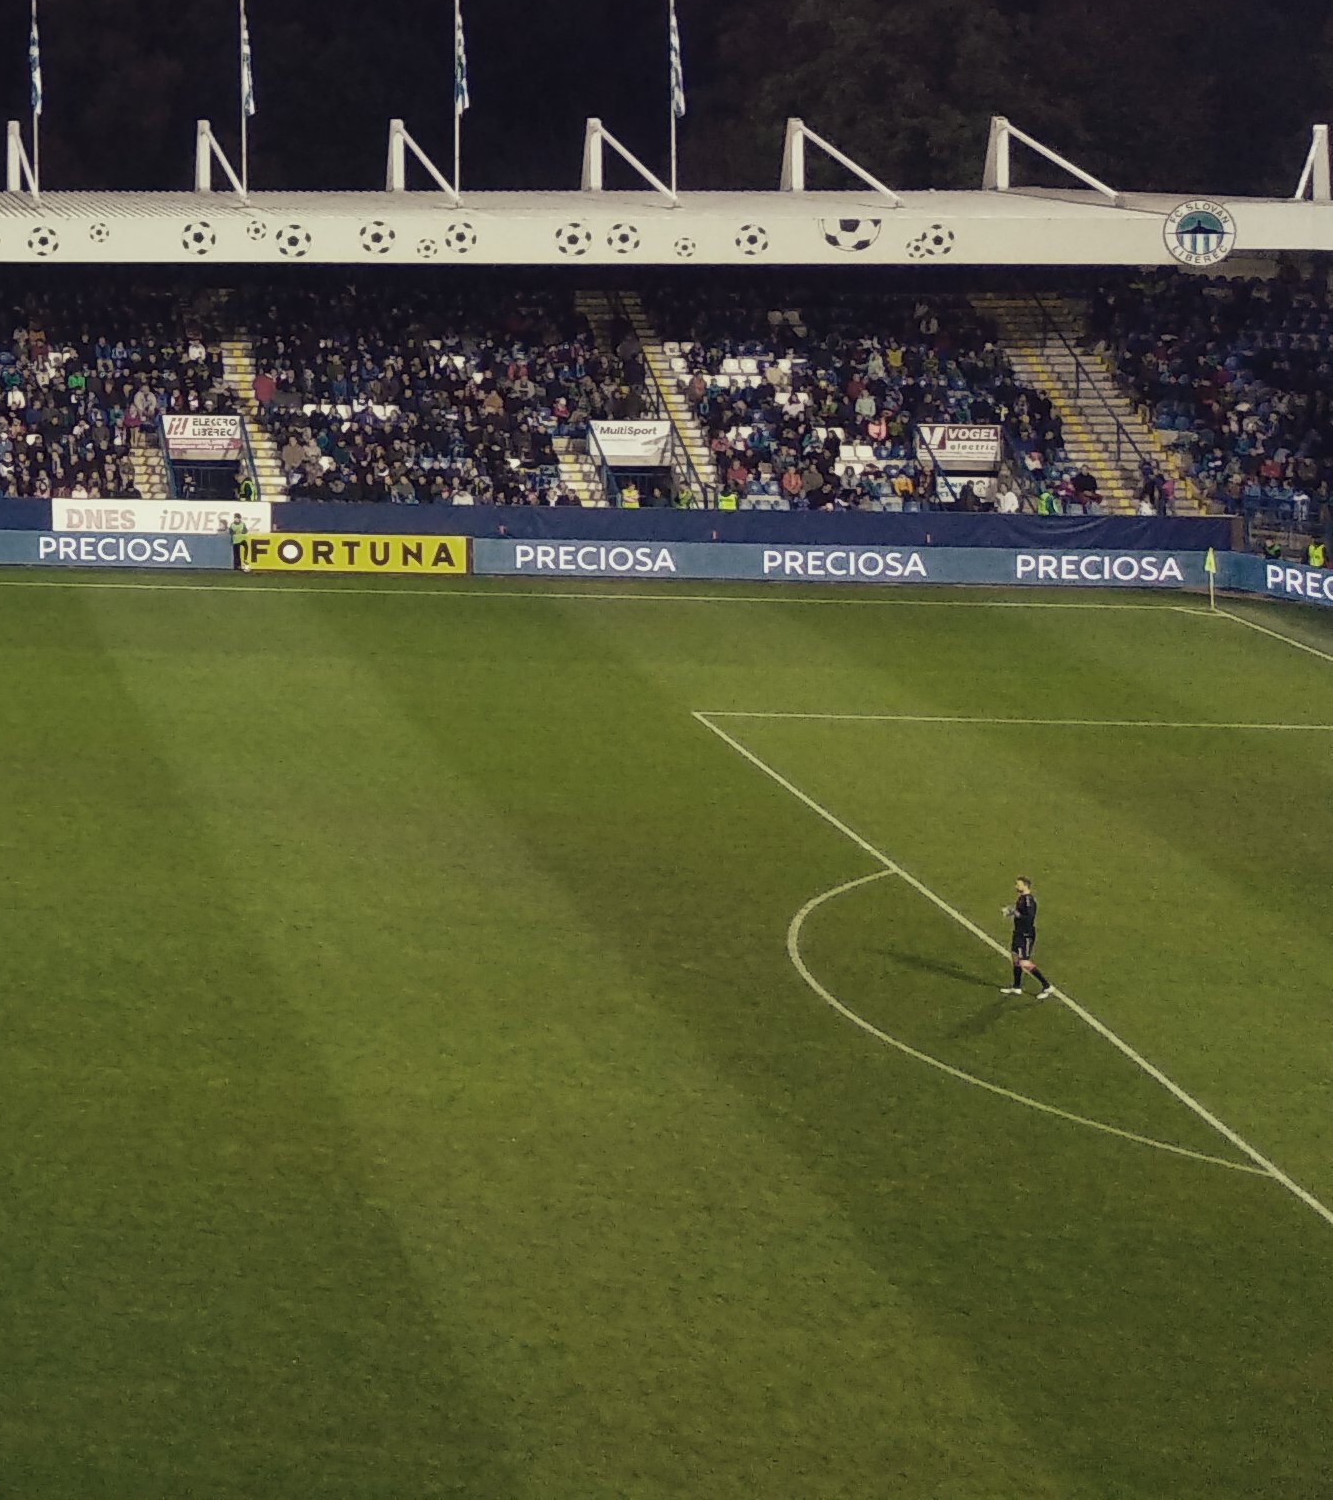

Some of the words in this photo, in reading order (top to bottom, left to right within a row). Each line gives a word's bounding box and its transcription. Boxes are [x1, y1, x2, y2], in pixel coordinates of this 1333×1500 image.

[1185, 203, 1229, 223] SLOVAN
[1172, 245, 1227, 263] LIBEREC
[600, 426, 657, 436] MultiSport
[948, 428, 997, 440] VOGEL
[66, 508, 136, 530] DNES
[39, 536, 192, 562] PRECIOSA
[250, 538, 456, 568] FORTUNA
[515, 545, 676, 572] PRECIOSA
[763, 550, 927, 577] PRECIOSA
[1016, 554, 1184, 581] PRECIOSA
